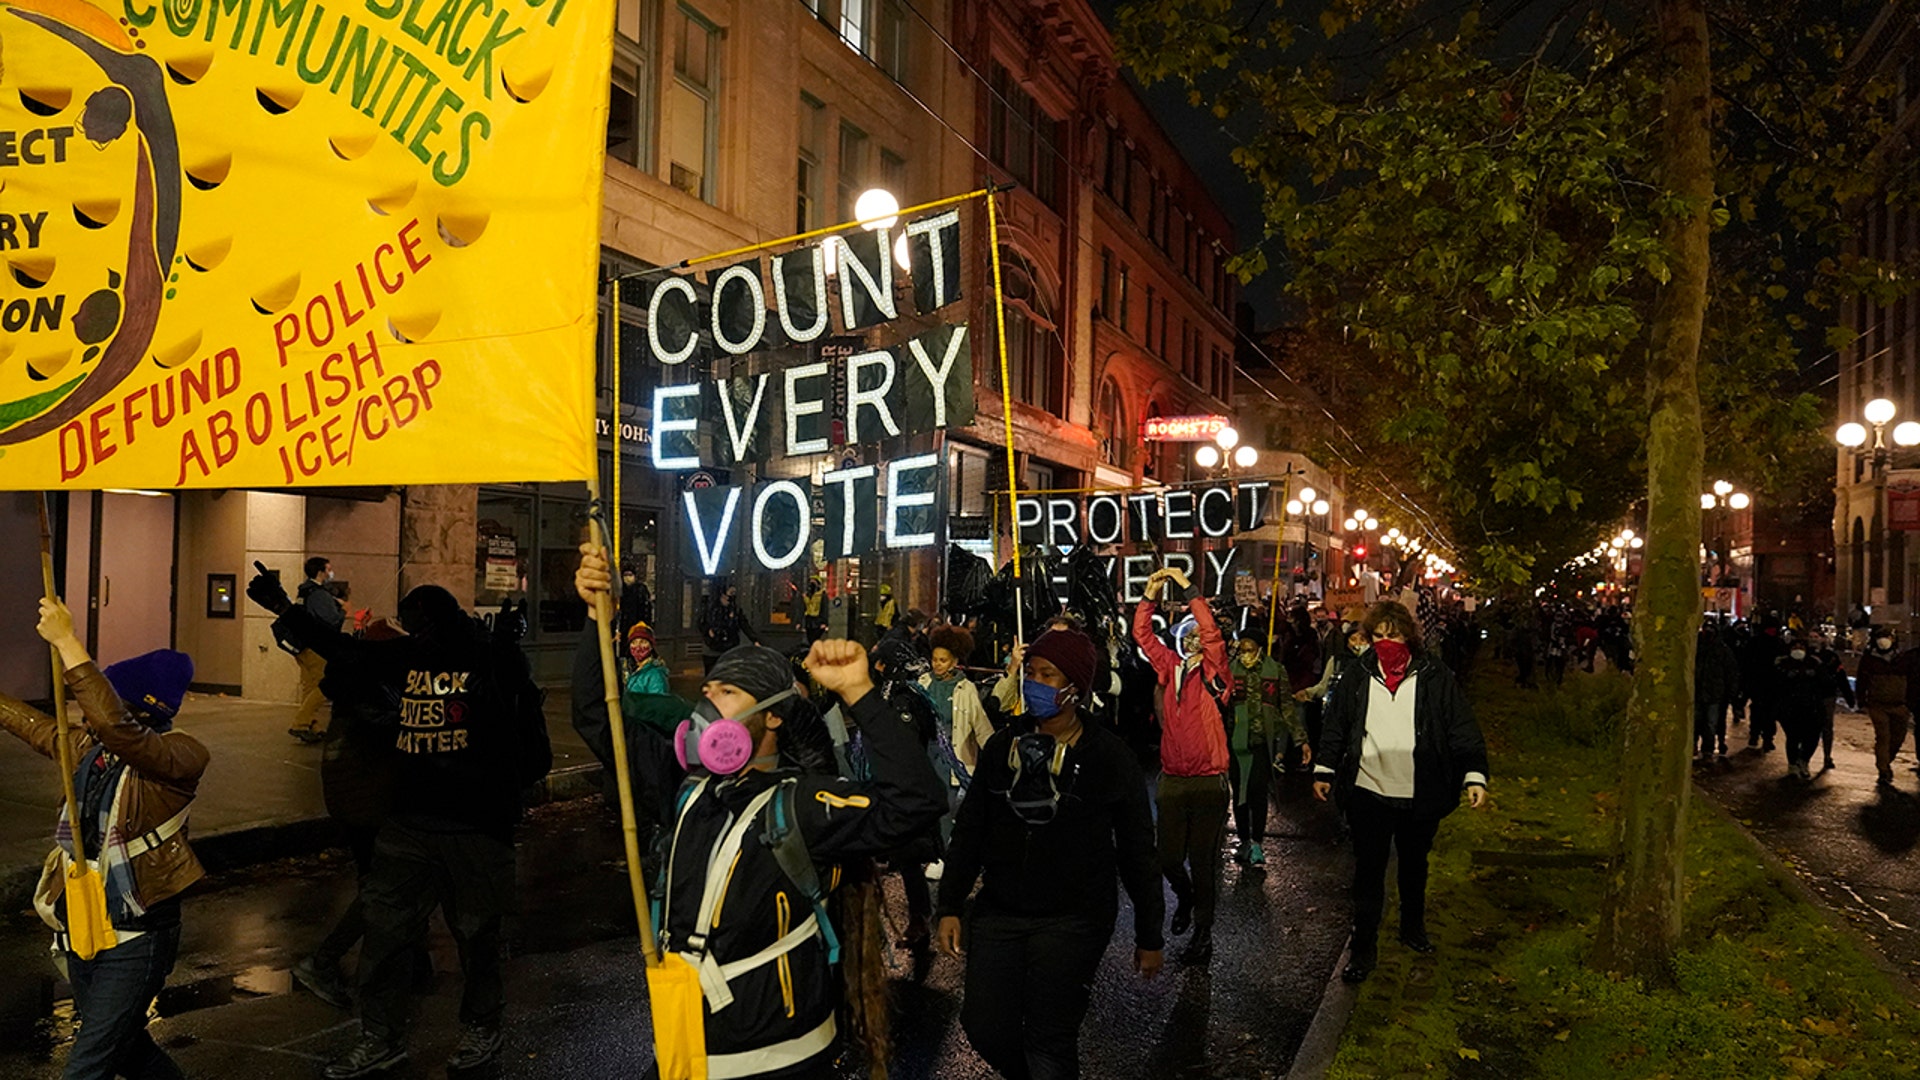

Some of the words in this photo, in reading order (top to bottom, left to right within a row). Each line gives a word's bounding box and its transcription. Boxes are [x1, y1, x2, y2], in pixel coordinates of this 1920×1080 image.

[367, 0, 525, 100] LACK
[0, 295, 65, 333] ON
[59, 347, 241, 482] DEFUND
[273, 218, 432, 367] POLICE
[648, 210, 960, 365] COUNT
[176, 331, 384, 486] ABOLISH
[279, 359, 441, 484] ICE/CBP
[650, 326, 967, 470] EVERY
[682, 453, 939, 576] VOTE
[1017, 482, 1269, 546] PROTECT
